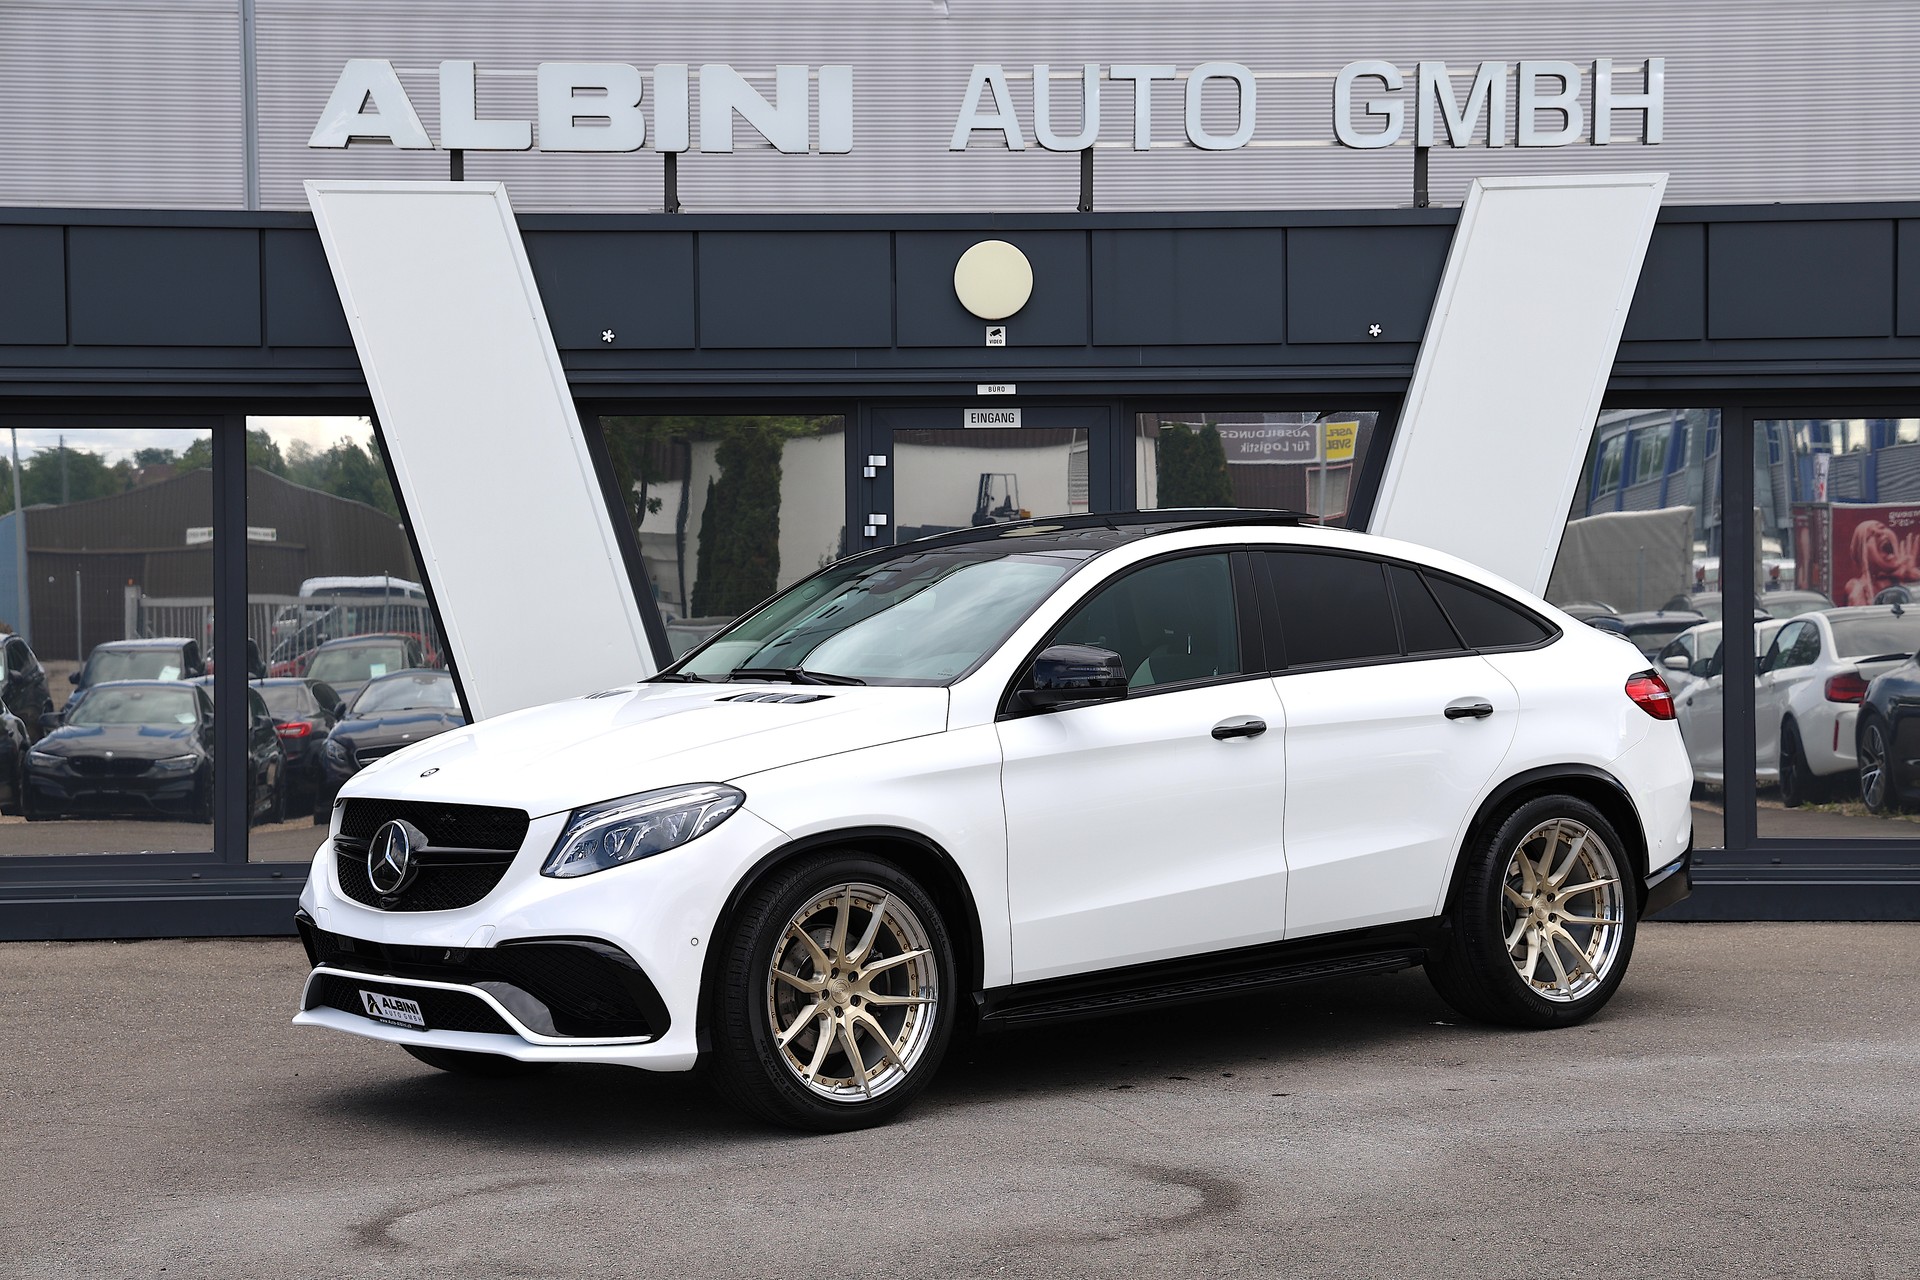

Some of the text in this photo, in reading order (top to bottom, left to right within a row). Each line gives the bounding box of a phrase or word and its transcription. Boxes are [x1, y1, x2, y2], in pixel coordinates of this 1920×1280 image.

[307, 58, 1665, 154] ALBINI AUTO GMBH
[988, 384, 1006, 392] BÜRO
[971, 412, 1015, 423] EINGANG
[382, 997, 419, 1015] ALBINI
[385, 1009, 401, 1018] AUTO
